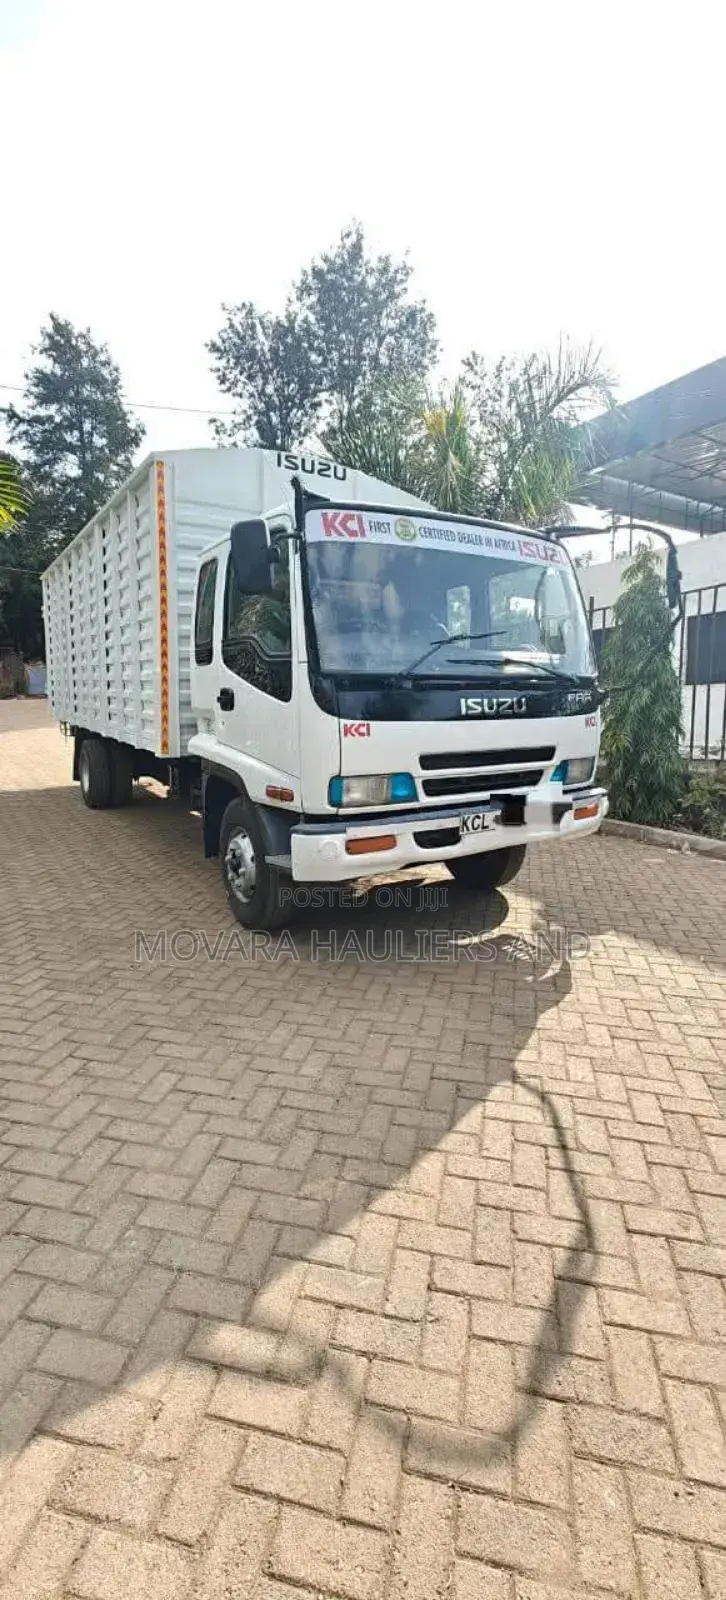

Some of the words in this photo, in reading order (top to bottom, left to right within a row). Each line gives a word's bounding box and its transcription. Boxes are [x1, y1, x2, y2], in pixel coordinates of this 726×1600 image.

[277, 452, 347, 481] ISUZU
[321, 512, 366, 538] KCI
[368, 520, 391, 534] FIRST
[419, 526, 456, 542] CERTIFIED
[458, 532, 482, 546] DEALER
[484, 536, 494, 550] IN
[495, 538, 517, 551] AFRICA
[460, 697, 527, 716] ISUZU
[343, 722, 371, 737] KCI
[461, 814, 490, 832] KCL
